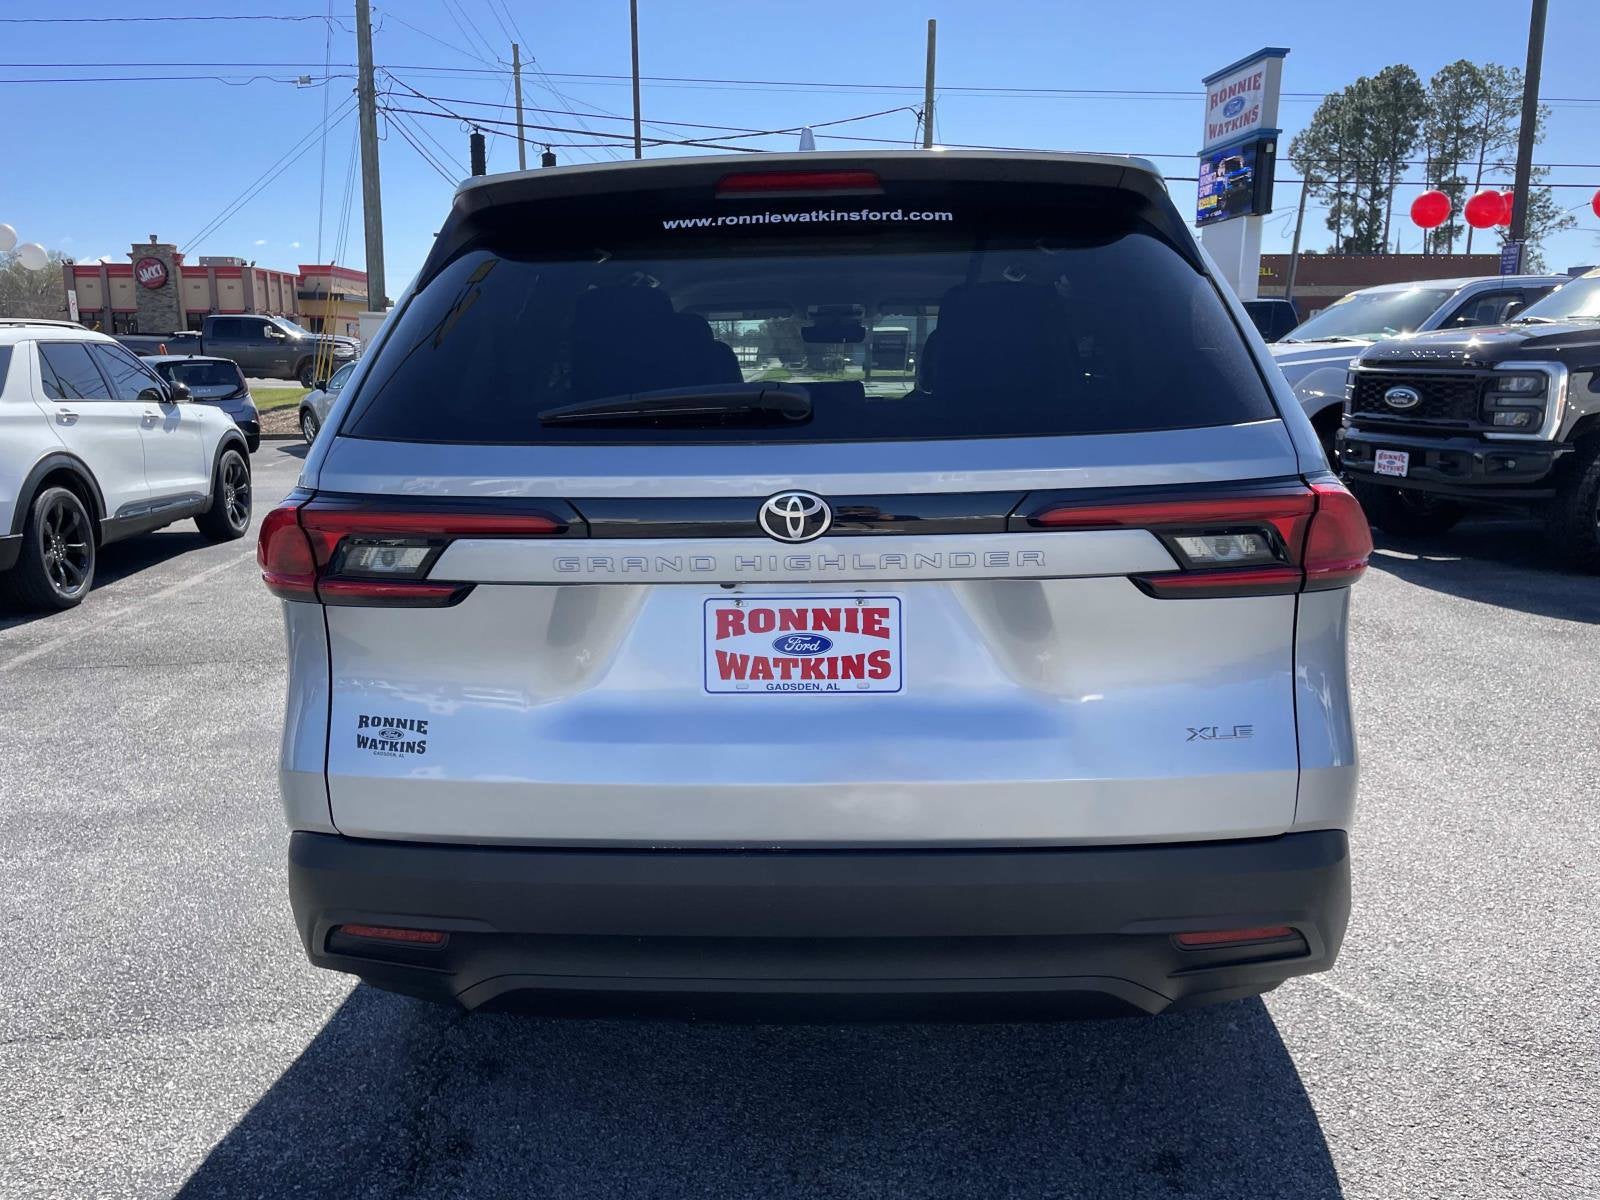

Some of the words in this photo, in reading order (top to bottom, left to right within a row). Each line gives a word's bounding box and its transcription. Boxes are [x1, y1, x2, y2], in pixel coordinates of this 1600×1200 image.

[1210, 72, 1262, 111] RONNIE
[1208, 104, 1259, 139] WATKINS
[663, 209, 953, 229] www.ronniewatkinsford.com
[553, 556, 716, 573] GRAND
[735, 551, 1046, 572] HIGHLANDER
[716, 608, 890, 640] RONNIE
[784, 636, 820, 651] Ford
[715, 650, 892, 680] WATKINS
[766, 683, 823, 691] GADSDEN,
[826, 683, 840, 691] AL
[358, 715, 428, 735] RONNIE
[1185, 725, 1254, 741] XLE
[357, 734, 427, 755] WATKINS
